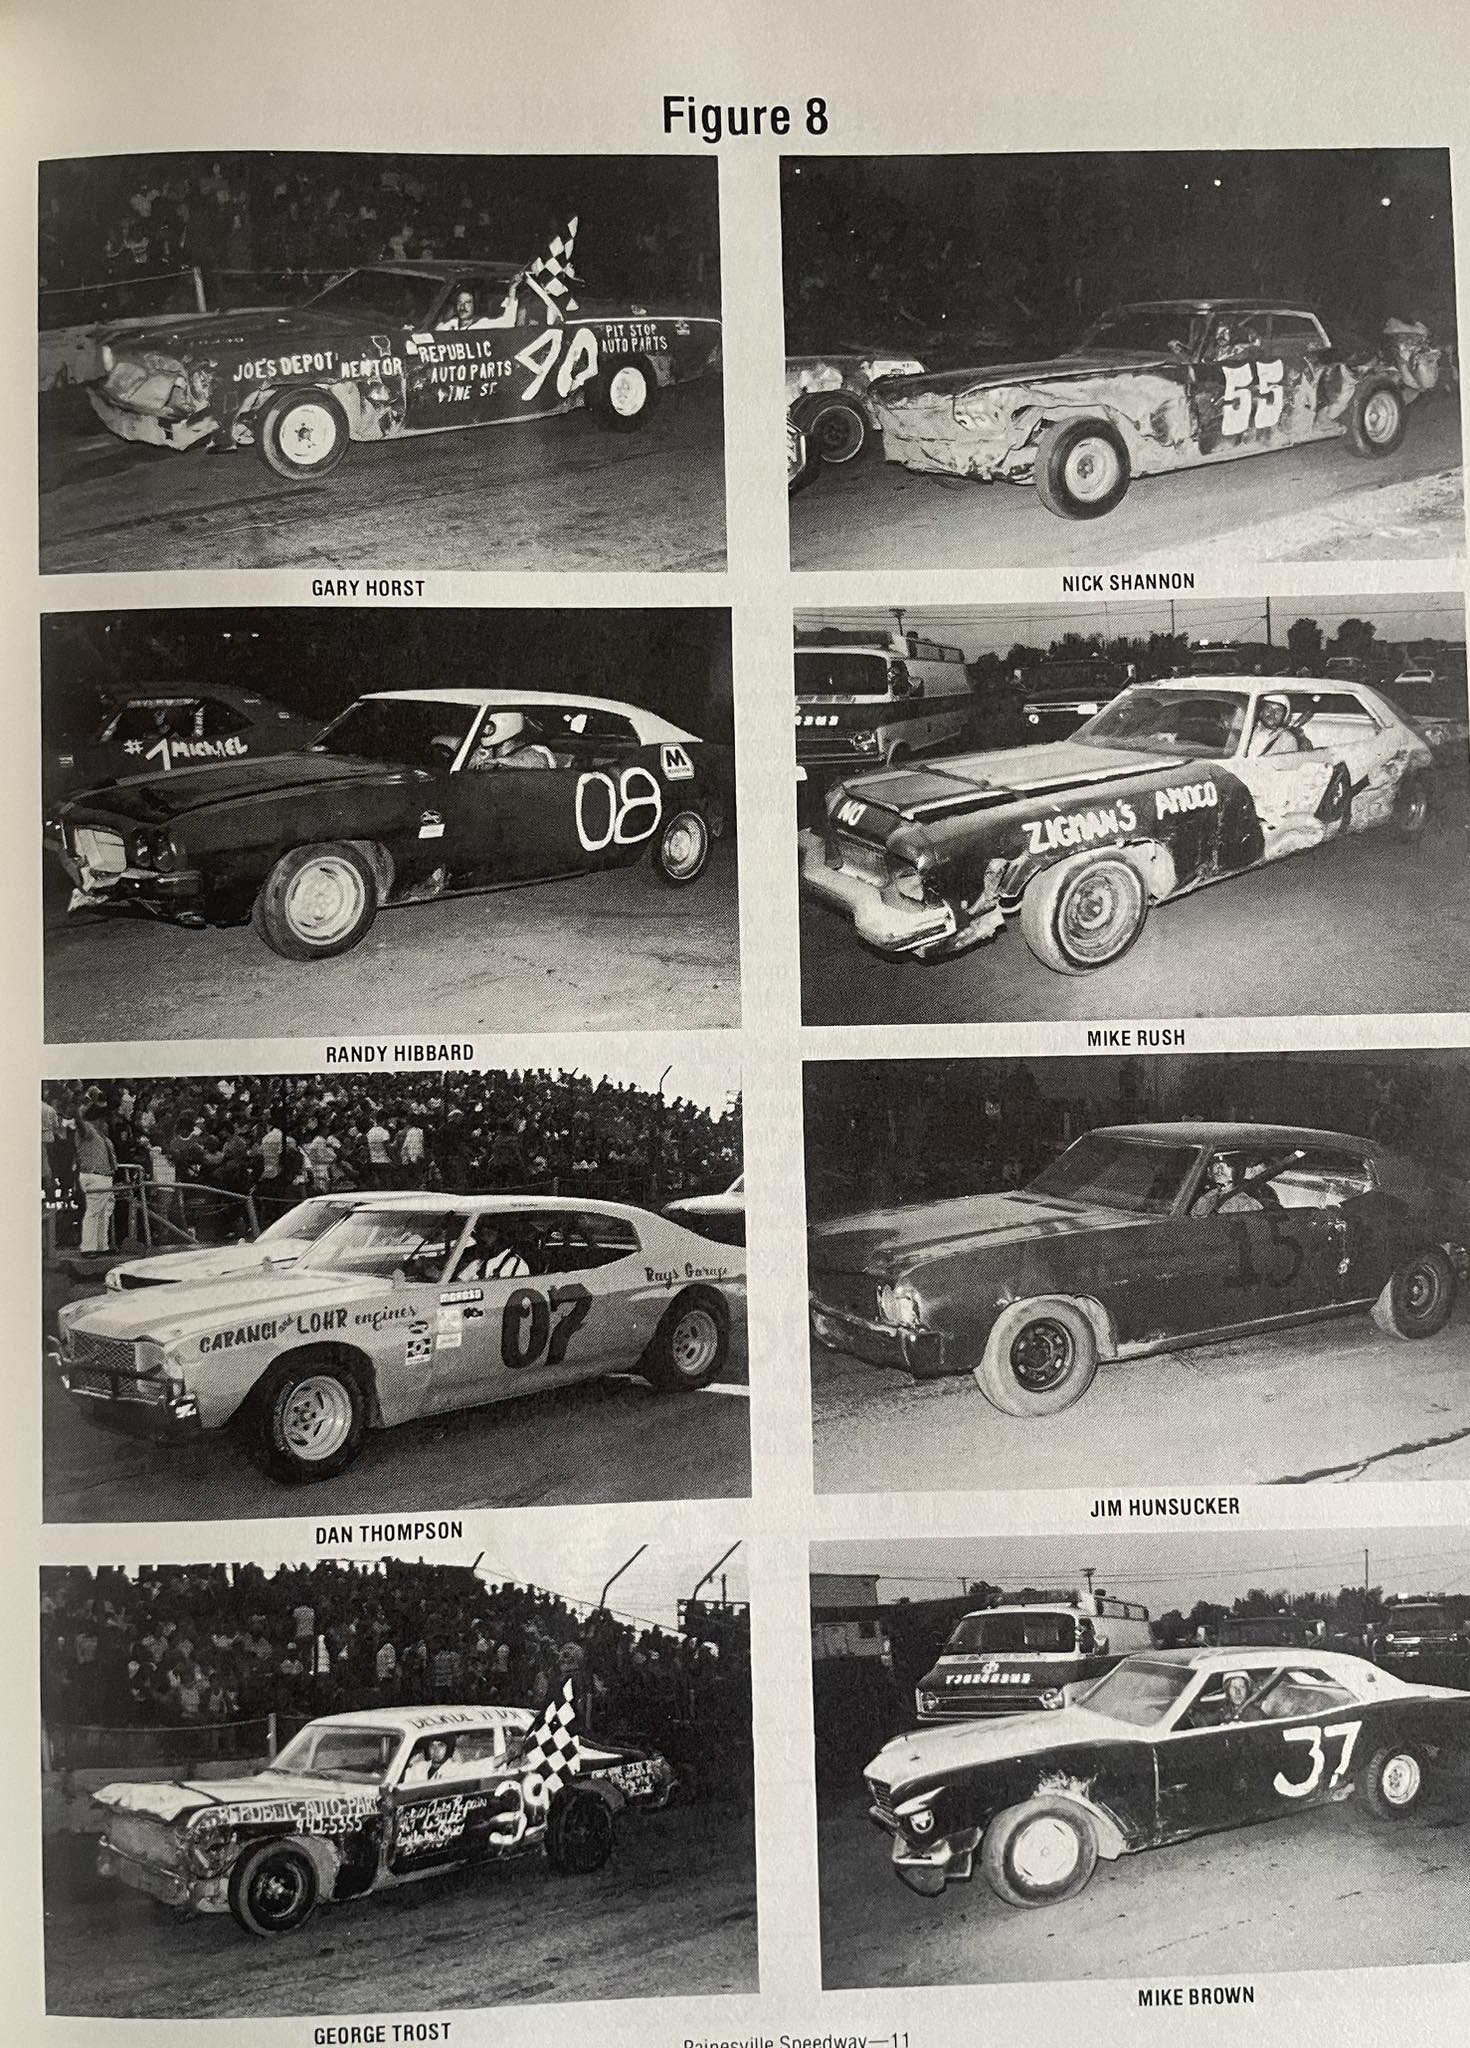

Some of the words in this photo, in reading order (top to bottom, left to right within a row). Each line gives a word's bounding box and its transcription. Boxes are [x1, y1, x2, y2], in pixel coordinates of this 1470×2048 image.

[664, 96, 790, 143] Figure
[806, 97, 828, 135] 8
[605, 325, 624, 338] PIT
[629, 324, 657, 337] STOP
[418, 341, 492, 363] REPUBLIC
[602, 338, 629, 353] AUTO
[631, 336, 668, 351] PARTS
[431, 365, 467, 383] AUTO
[470, 361, 512, 380] PARTS
[514, 328, 599, 400] 90
[1222, 359, 1284, 436] 55
[312, 580, 360, 596] GARY
[366, 580, 425, 596] HORST
[1063, 575, 1103, 591] NICK
[1109, 573, 1194, 590] SHANNON
[666, 749, 687, 767] M
[576, 767, 662, 851] 08
[1155, 781, 1218, 820] AMOCO
[1088, 1030, 1131, 1046] MIKE
[1138, 1029, 1185, 1046] RUSH
[326, 1046, 388, 1063] RANDY
[394, 1044, 474, 1062] HIBBARD
[1223, 1215, 1303, 1289] 15
[297, 1308, 348, 1334] LOHR
[354, 1305, 419, 1331] engines
[501, 1283, 593, 1369] 07
[1091, 1499, 1122, 1517] JIM
[1129, 1497, 1240, 1516] HUNSUCKER
[316, 1526, 352, 1544] DAN
[360, 1521, 462, 1542] THOMPSON
[1273, 1721, 1362, 1797] 37
[1139, 1989, 1183, 2006] MIKE
[1189, 1986, 1254, 2005] BROWN
[314, 2026, 386, 2045] GEORGE
[392, 2022, 451, 2041] TROST
